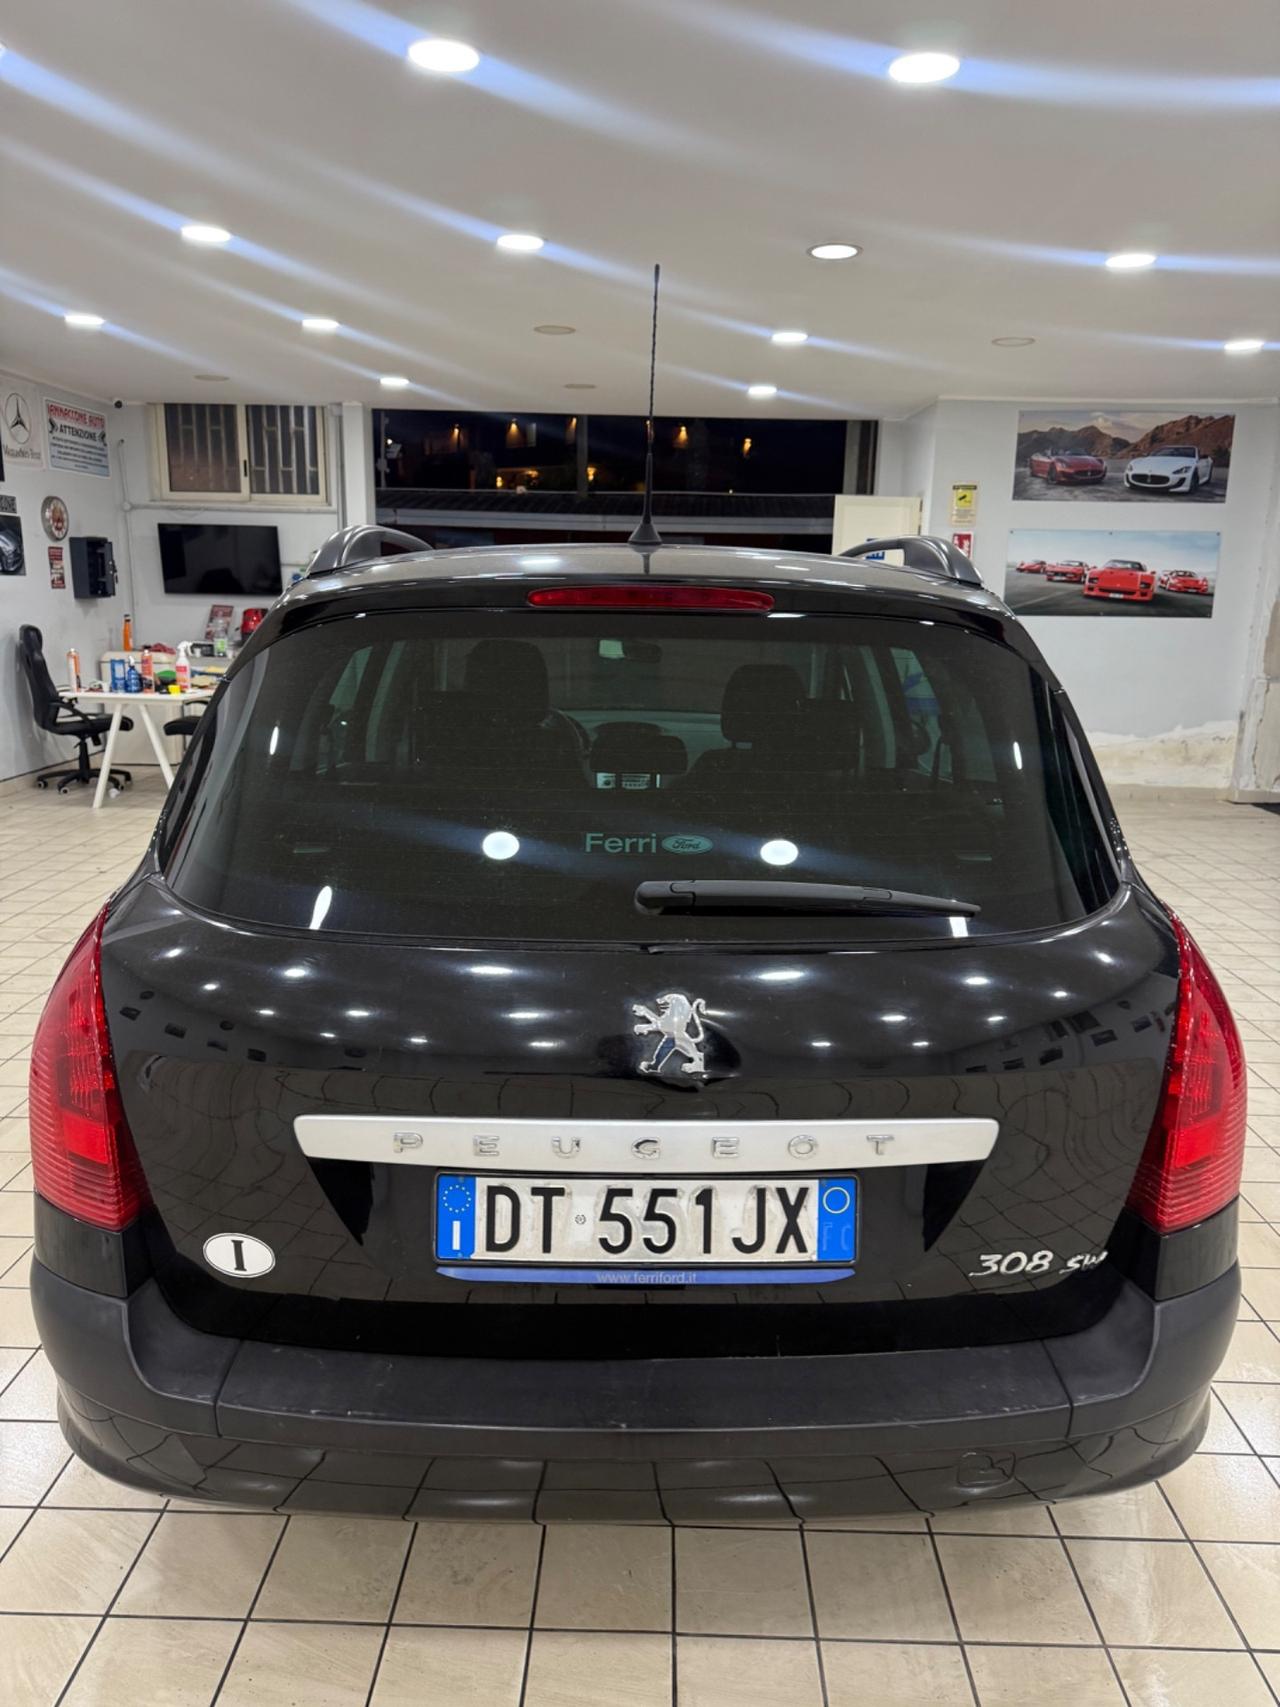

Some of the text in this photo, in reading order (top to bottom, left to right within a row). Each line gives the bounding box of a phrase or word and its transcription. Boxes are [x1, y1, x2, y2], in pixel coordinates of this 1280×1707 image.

[59, 424, 97, 442] ATTENZIONE
[585, 833, 657, 854] Ferri
[393, 1132, 895, 1159] PEUGEOT
[485, 1185, 566, 1254] DT
[230, 1239, 247, 1272] I
[968, 1250, 1054, 1277] 308
[595, 1271, 697, 1285] www.ferriford.it
